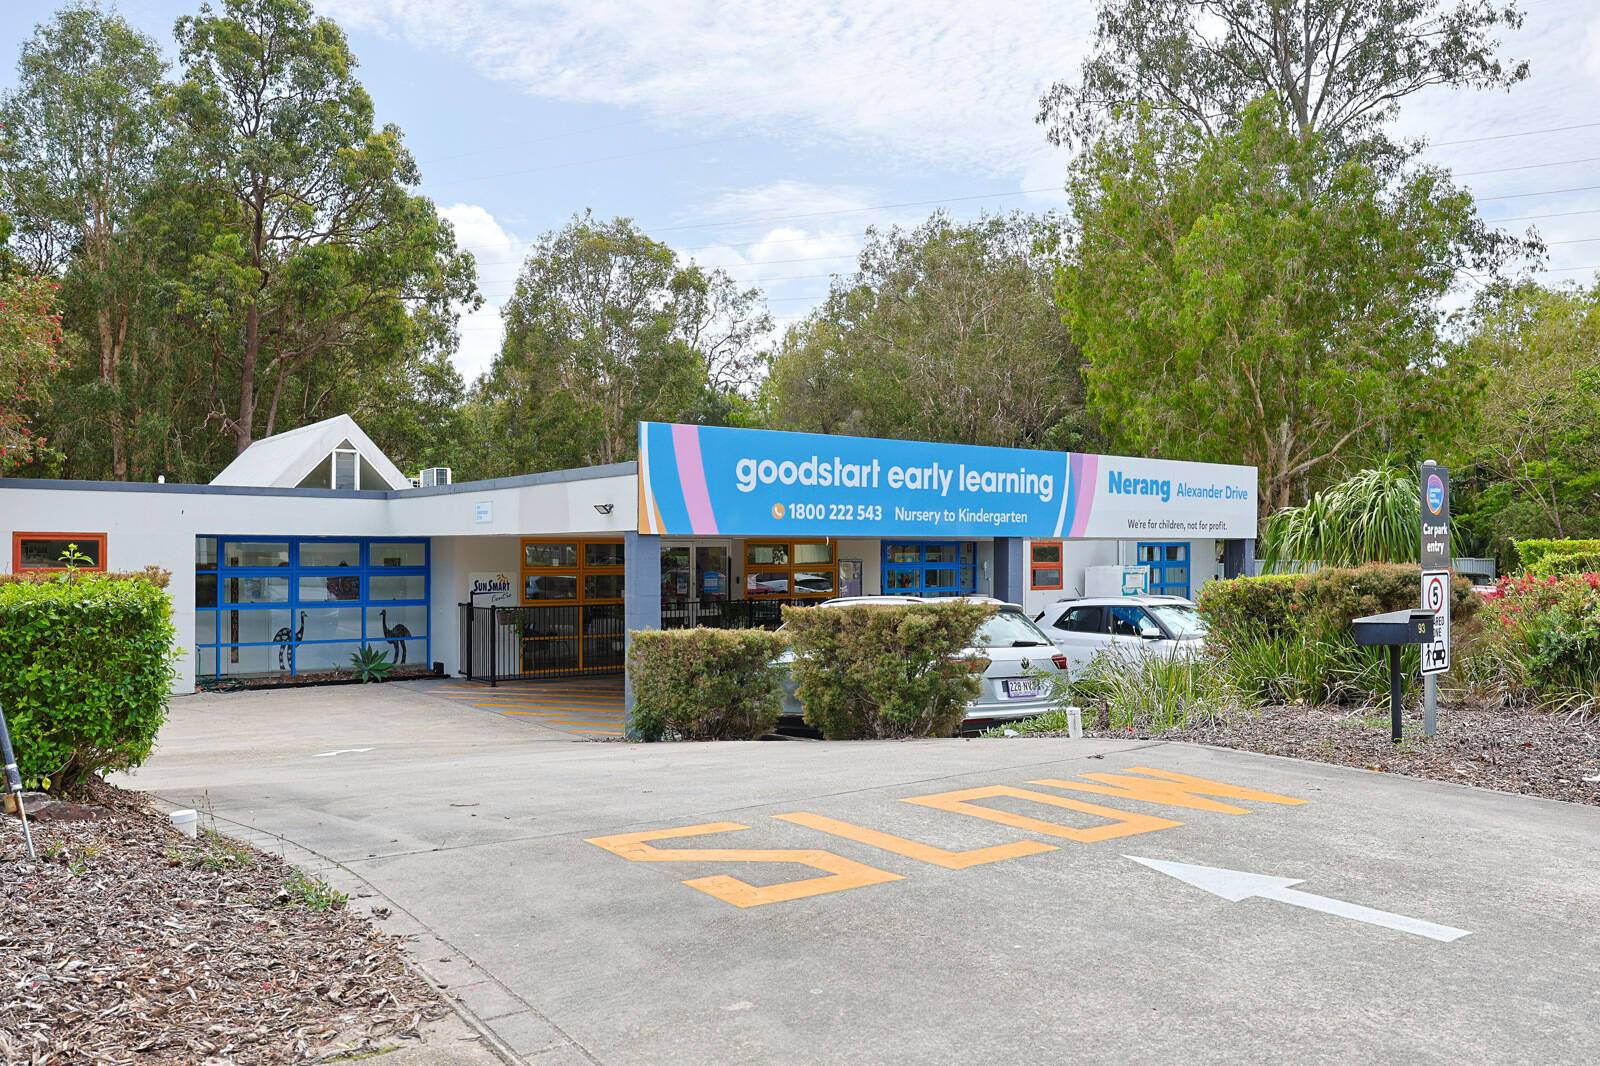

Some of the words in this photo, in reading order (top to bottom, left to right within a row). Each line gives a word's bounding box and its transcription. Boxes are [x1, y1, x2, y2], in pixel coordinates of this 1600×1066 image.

[736, 455, 881, 493] goodstart
[887, 462, 953, 497] early
[959, 463, 1053, 503] learning
[1108, 470, 1171, 503] Nerang
[1176, 483, 1223, 499] Alexander
[1225, 486, 1248, 500] Drive
[788, 503, 826, 520] 1800
[829, 504, 854, 521] 222
[856, 504, 882, 521] 543
[895, 506, 941, 525] Nursery
[943, 509, 955, 522] to
[958, 508, 1028, 526] Kindergarten
[1127, 519, 1146, 529] We're
[1148, 519, 1157, 529] for
[1158, 519, 1186, 531] children,
[1187, 521, 1197, 530] not
[1199, 520, 1208, 530] for
[1208, 521, 1227, 532] profit.
[1423, 522, 1433, 535] Car
[1433, 522, 1448, 538] park
[1427, 541, 1445, 555] entry
[1432, 586, 1439, 606] 5
[1417, 623, 1426, 634] 93
[584, 766, 1308, 908] SLOW
